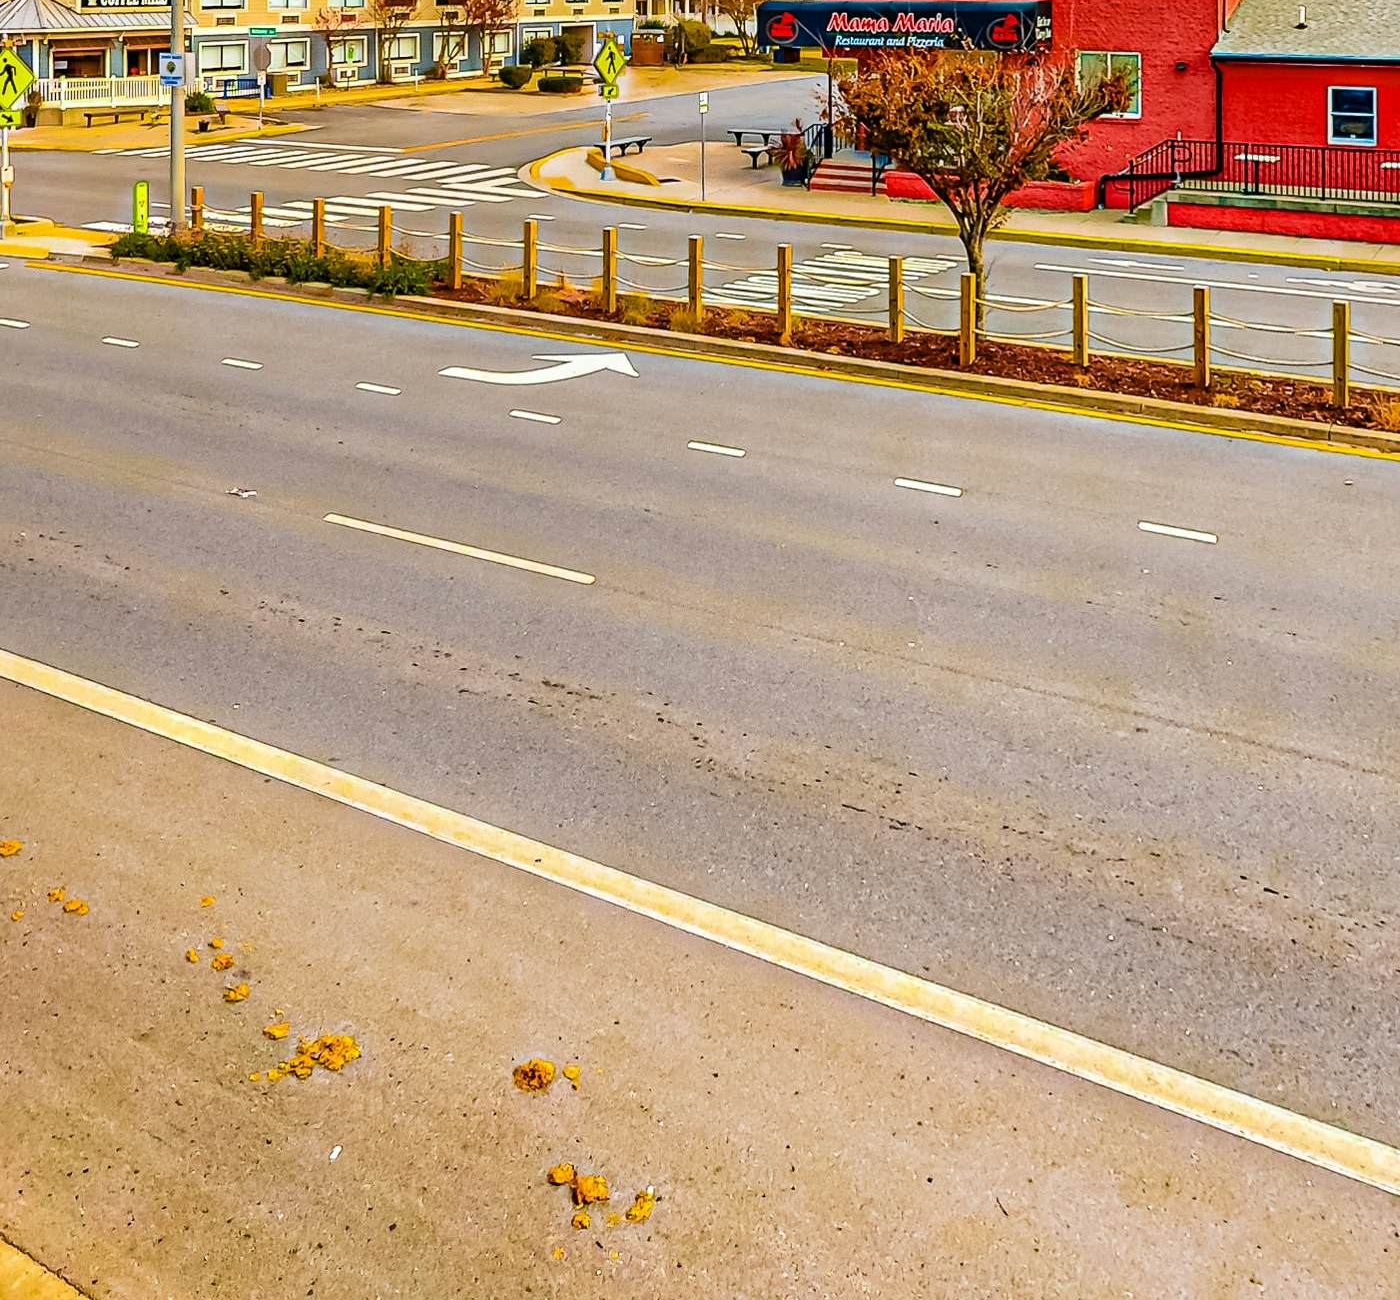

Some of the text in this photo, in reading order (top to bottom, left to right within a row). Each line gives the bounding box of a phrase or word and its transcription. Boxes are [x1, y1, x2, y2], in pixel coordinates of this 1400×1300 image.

[826, 12, 954, 33] Mama Maria
[835, 35, 945, 48] Restaurant and Pizzeria
